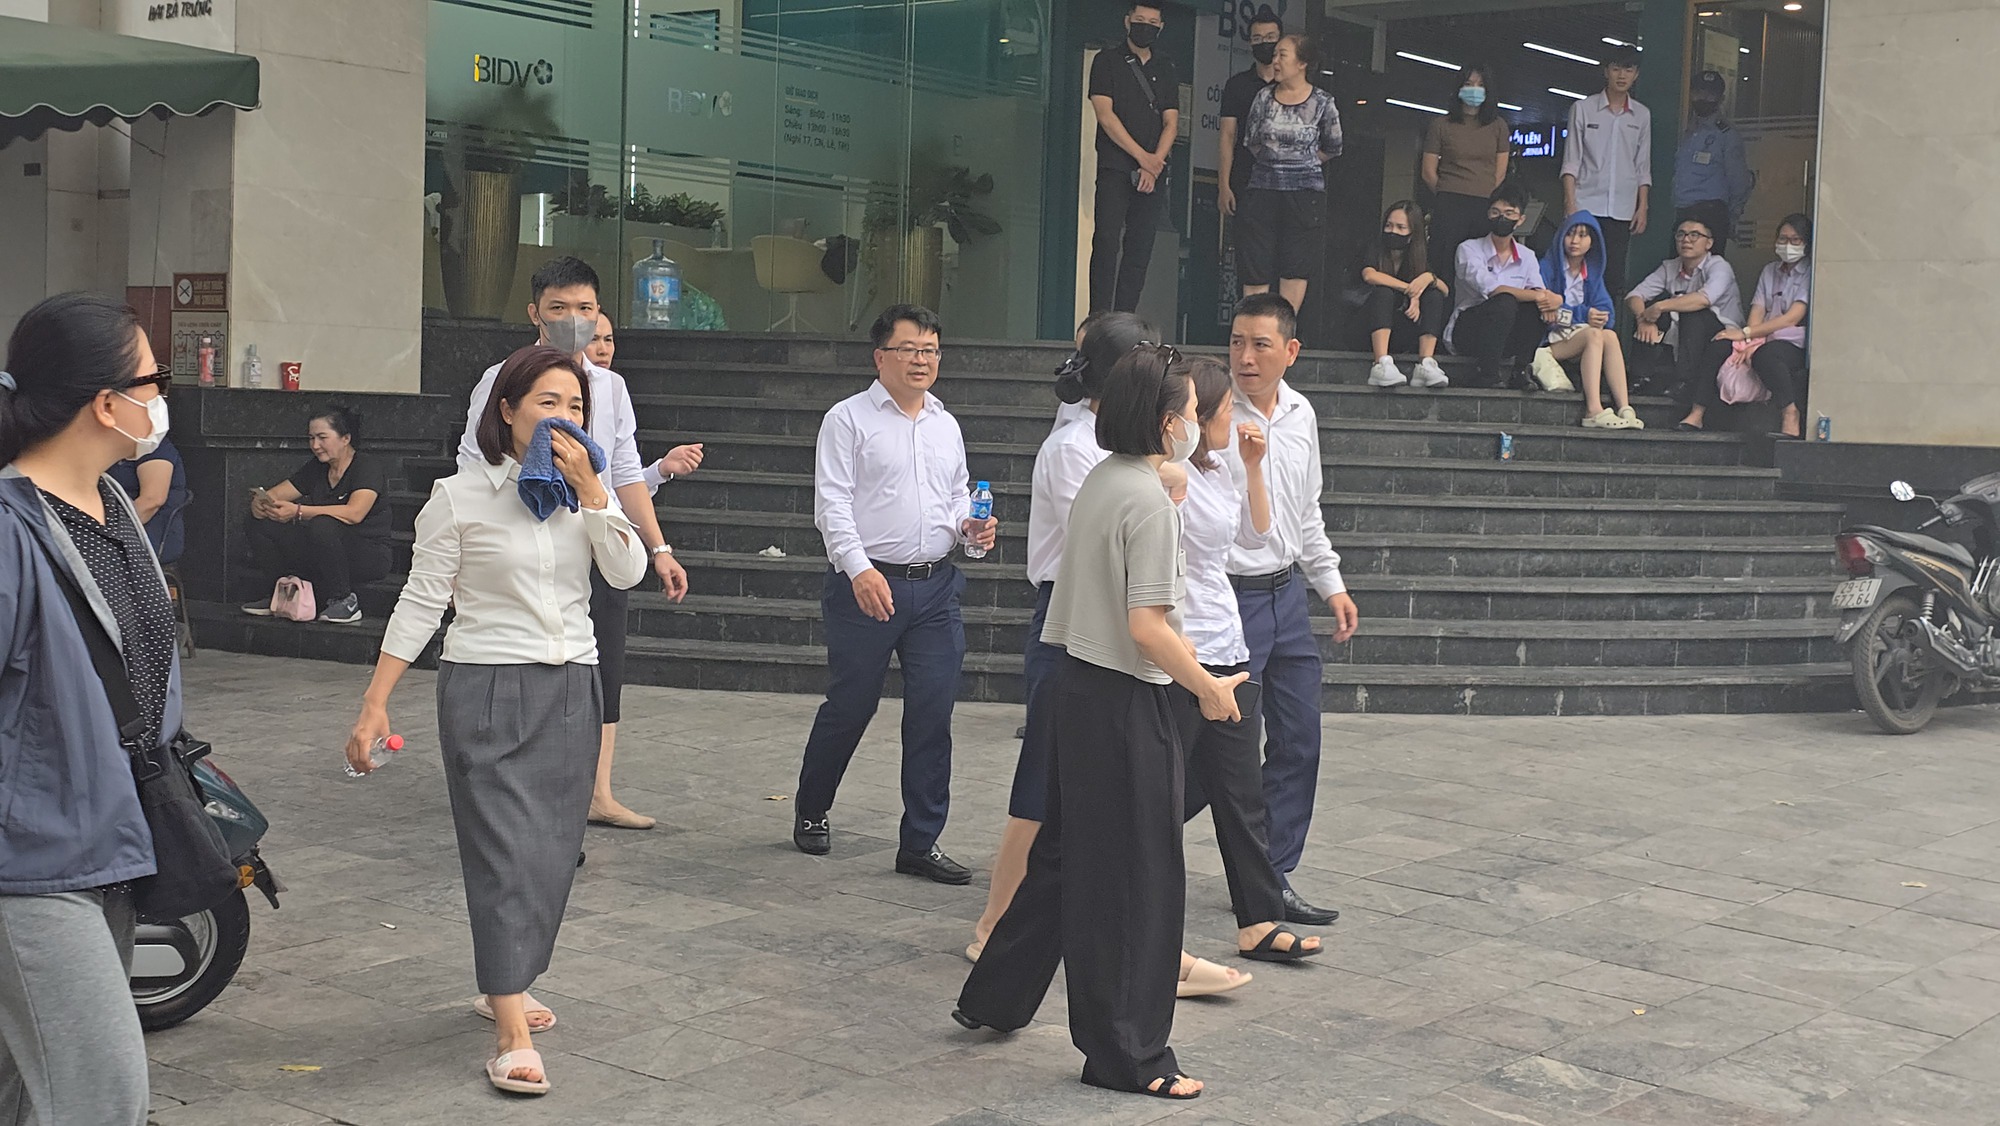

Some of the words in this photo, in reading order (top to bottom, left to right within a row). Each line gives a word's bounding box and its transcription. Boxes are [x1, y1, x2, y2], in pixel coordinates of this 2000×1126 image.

[474, 54, 534, 88] BIDV
[1841, 580, 1873, 593] 29-C1
[1834, 592, 1870, 607] 577.64
